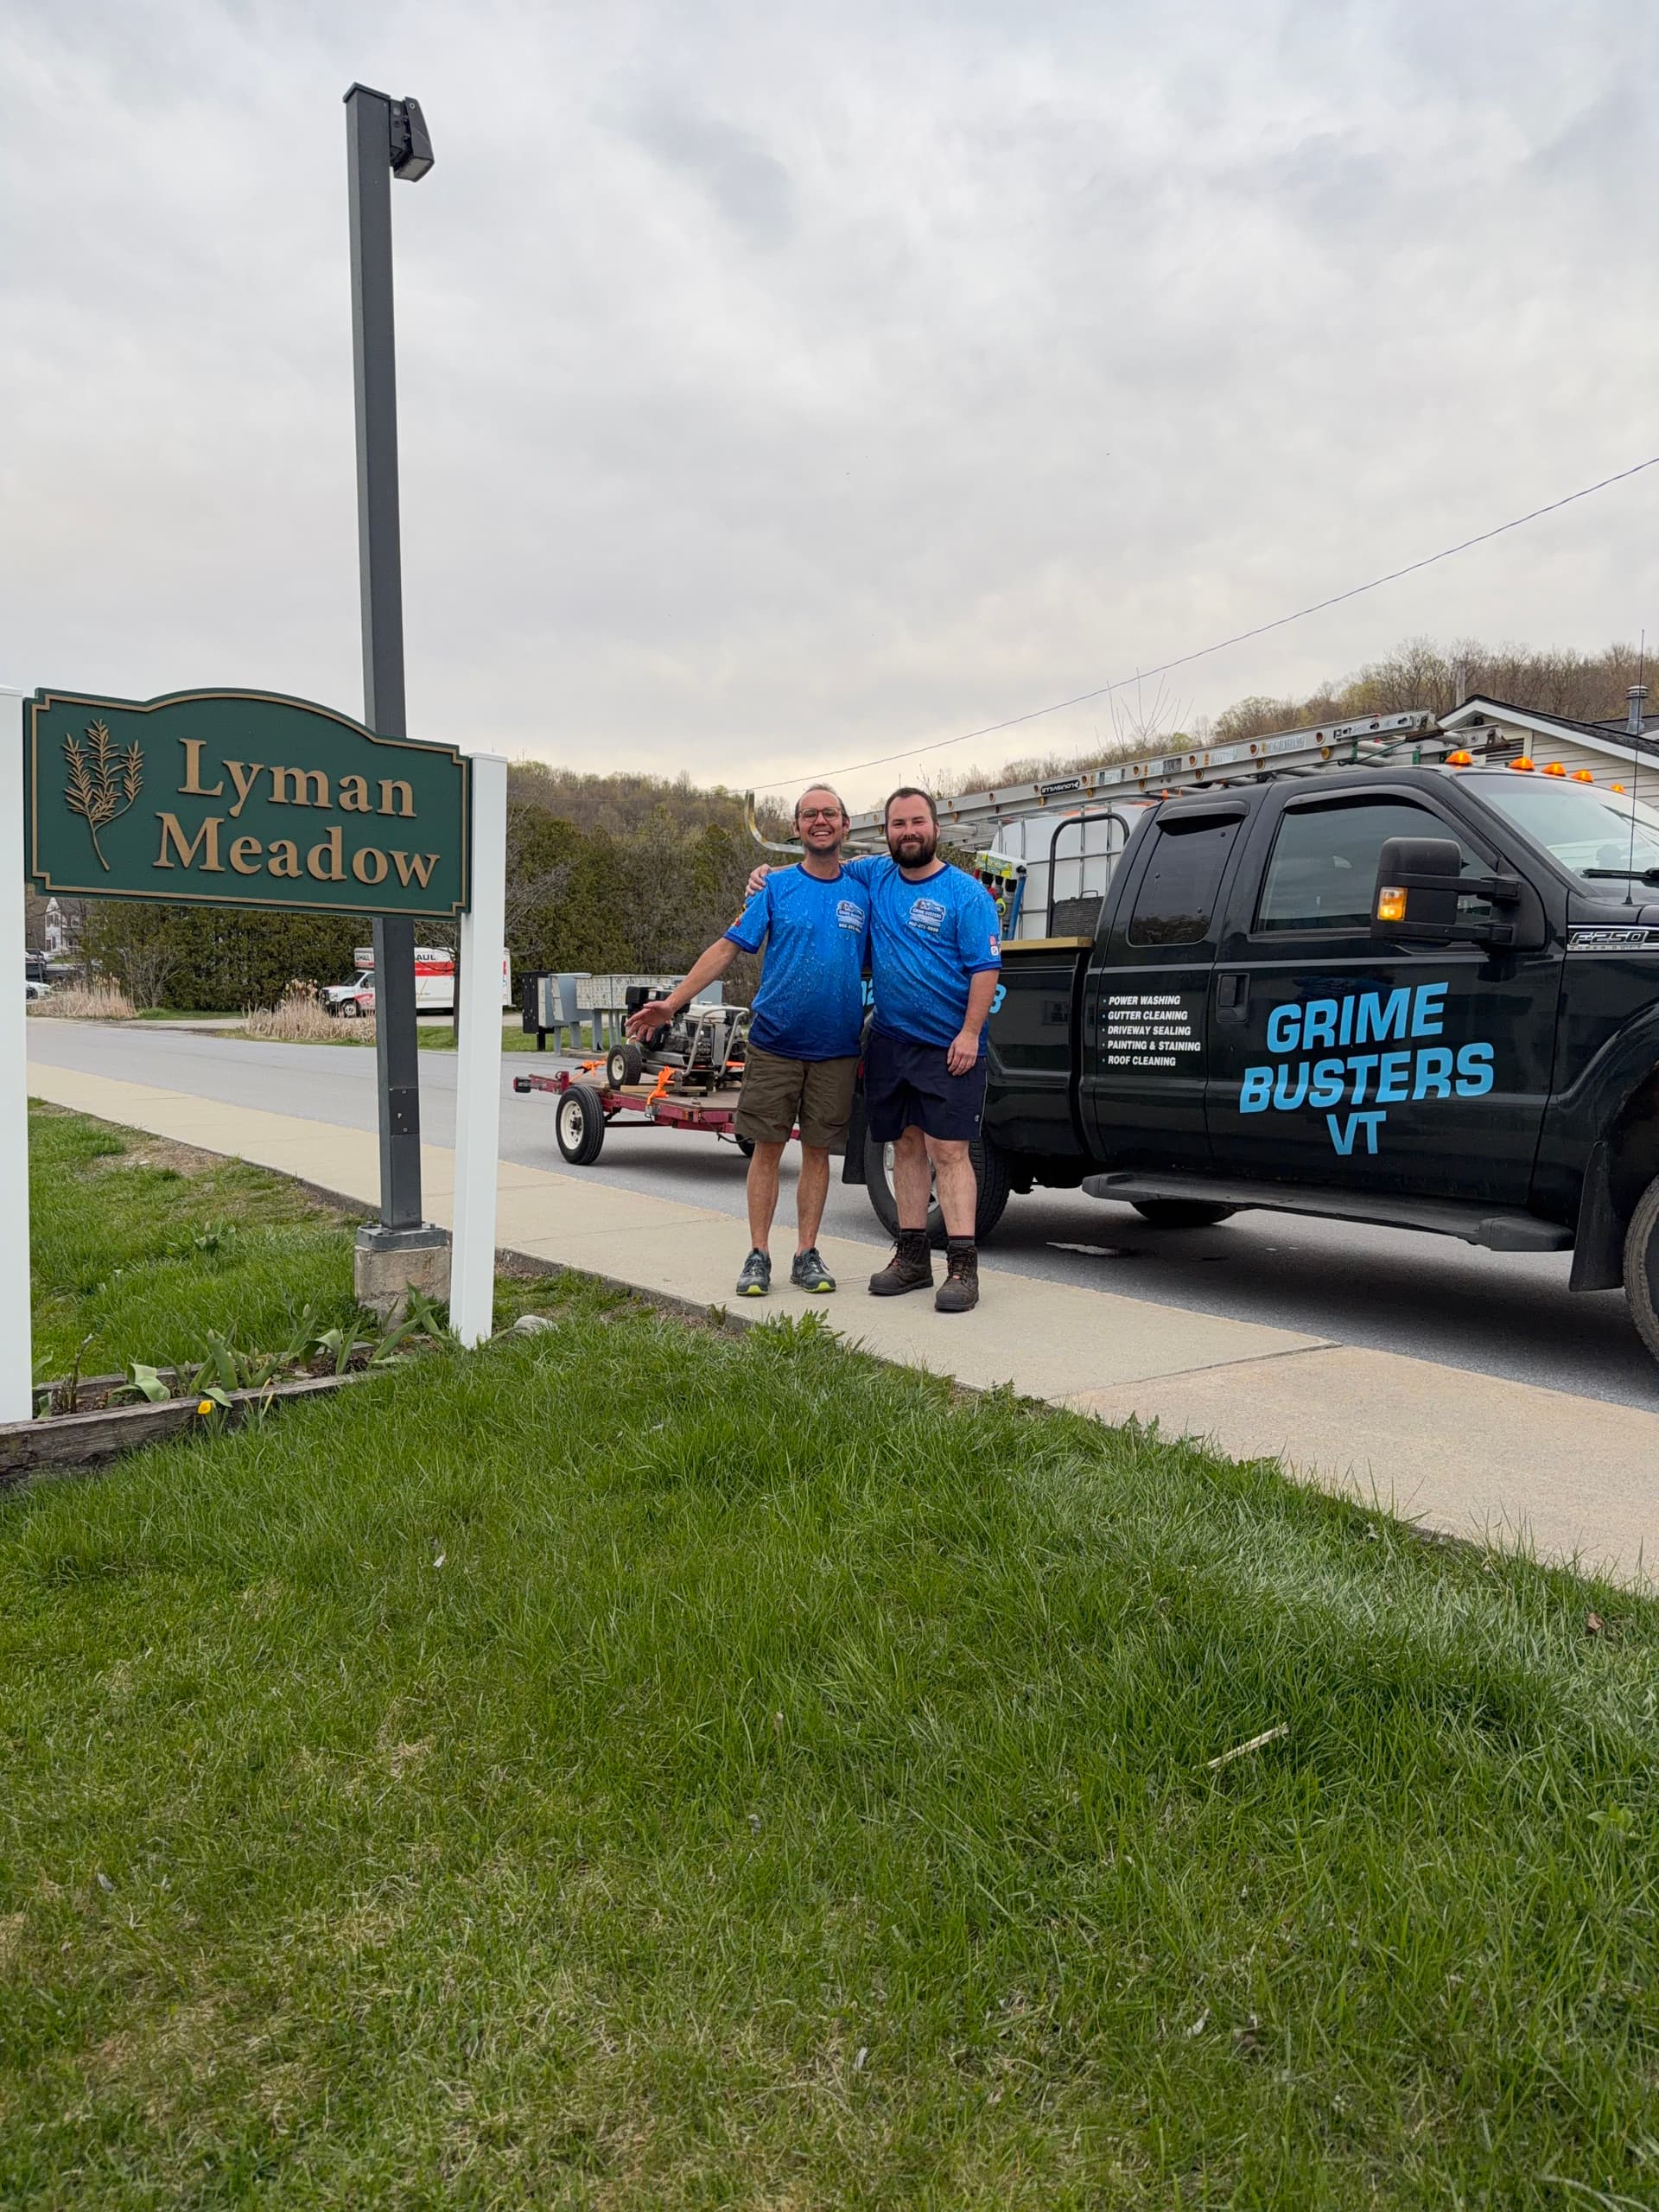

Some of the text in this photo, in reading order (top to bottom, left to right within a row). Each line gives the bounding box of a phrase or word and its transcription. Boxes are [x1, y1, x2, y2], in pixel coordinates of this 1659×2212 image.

[177, 737, 416, 817] Lyman
[153, 811, 441, 889] Meadow
[1109, 995, 1181, 1005] POWER WASHING
[1108, 1011, 1188, 1020] GUTTER CLEANING
[1267, 982, 1449, 1053] GRIME
[1108, 1026, 1192, 1036] DRIVEWAY SEALING
[1108, 1040, 1201, 1052] PAINTING & STAINING
[1108, 1056, 1176, 1066] ROOF CLEANING
[1239, 1042, 1494, 1114] BUSTERS
[1326, 1110, 1387, 1155] VT
